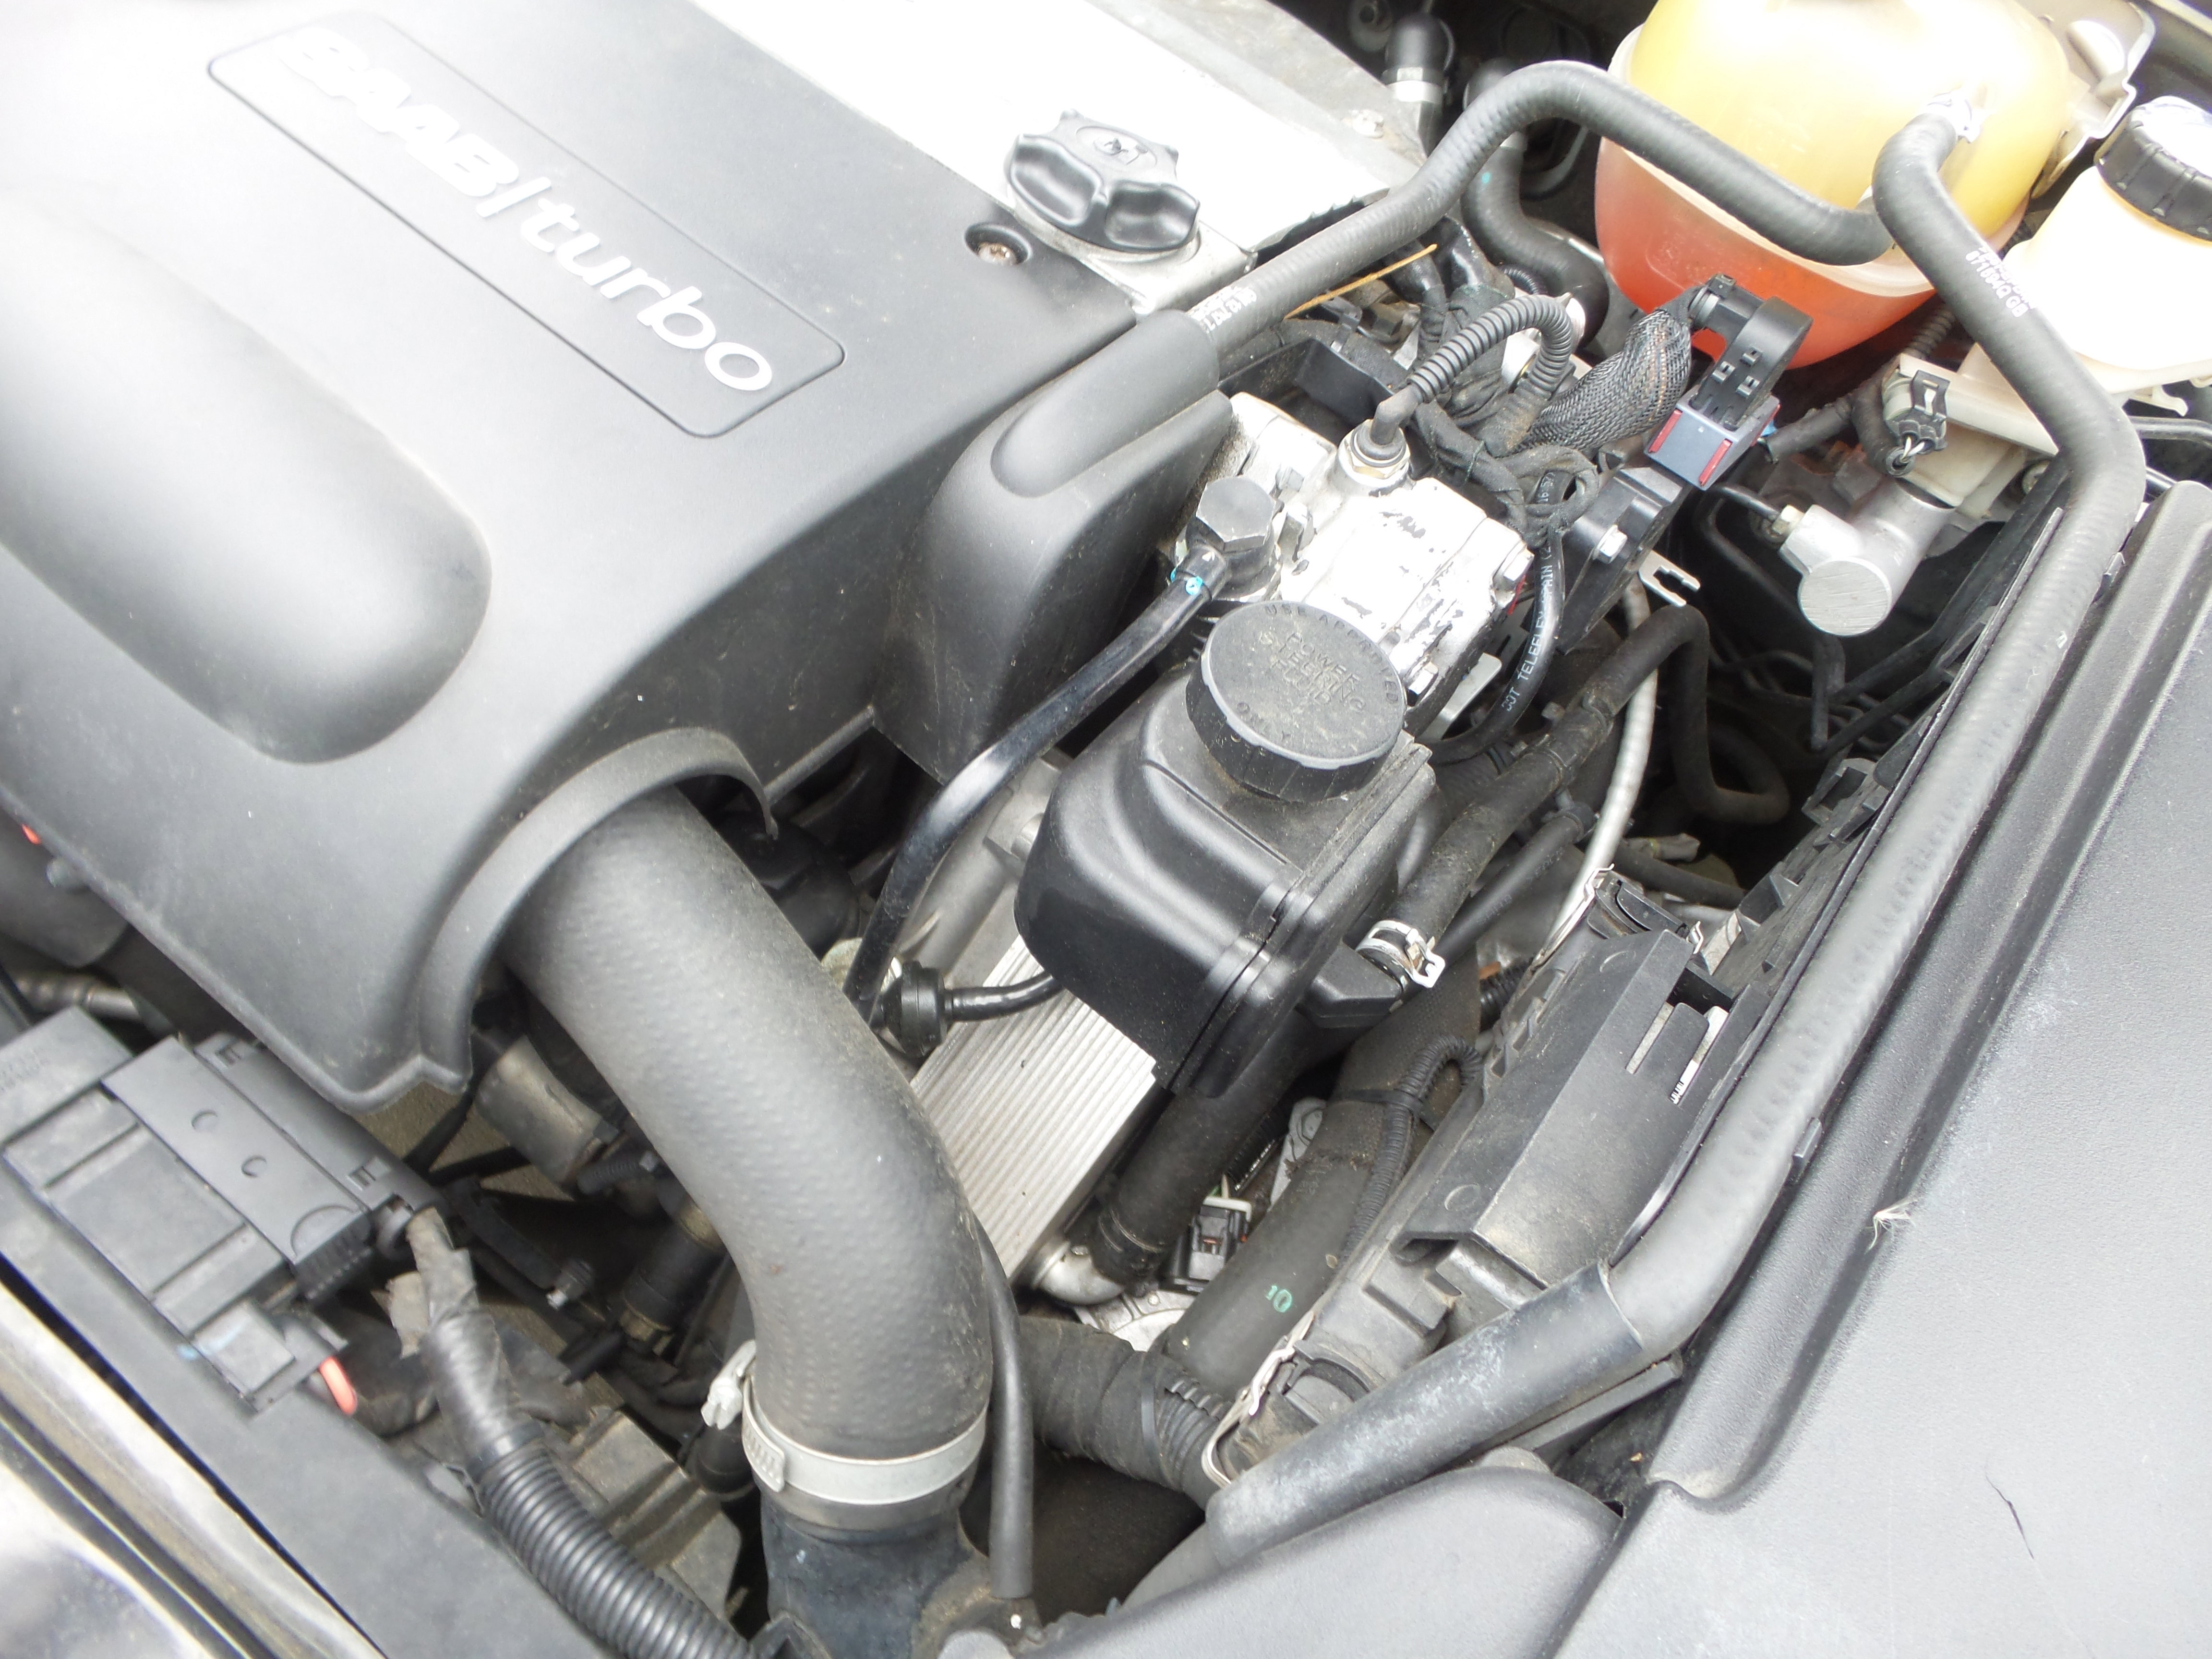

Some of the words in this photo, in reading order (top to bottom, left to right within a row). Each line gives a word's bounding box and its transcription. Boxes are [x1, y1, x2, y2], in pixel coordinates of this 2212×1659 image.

[1259, 631, 1366, 712] STEERING
[1264, 604, 1306, 616] USE
[1319, 613, 1399, 705] APPROVED
[1271, 659, 1333, 705] FLUID
[1288, 632, 1360, 692] POWER
[1265, 1284, 1293, 1313] 10
